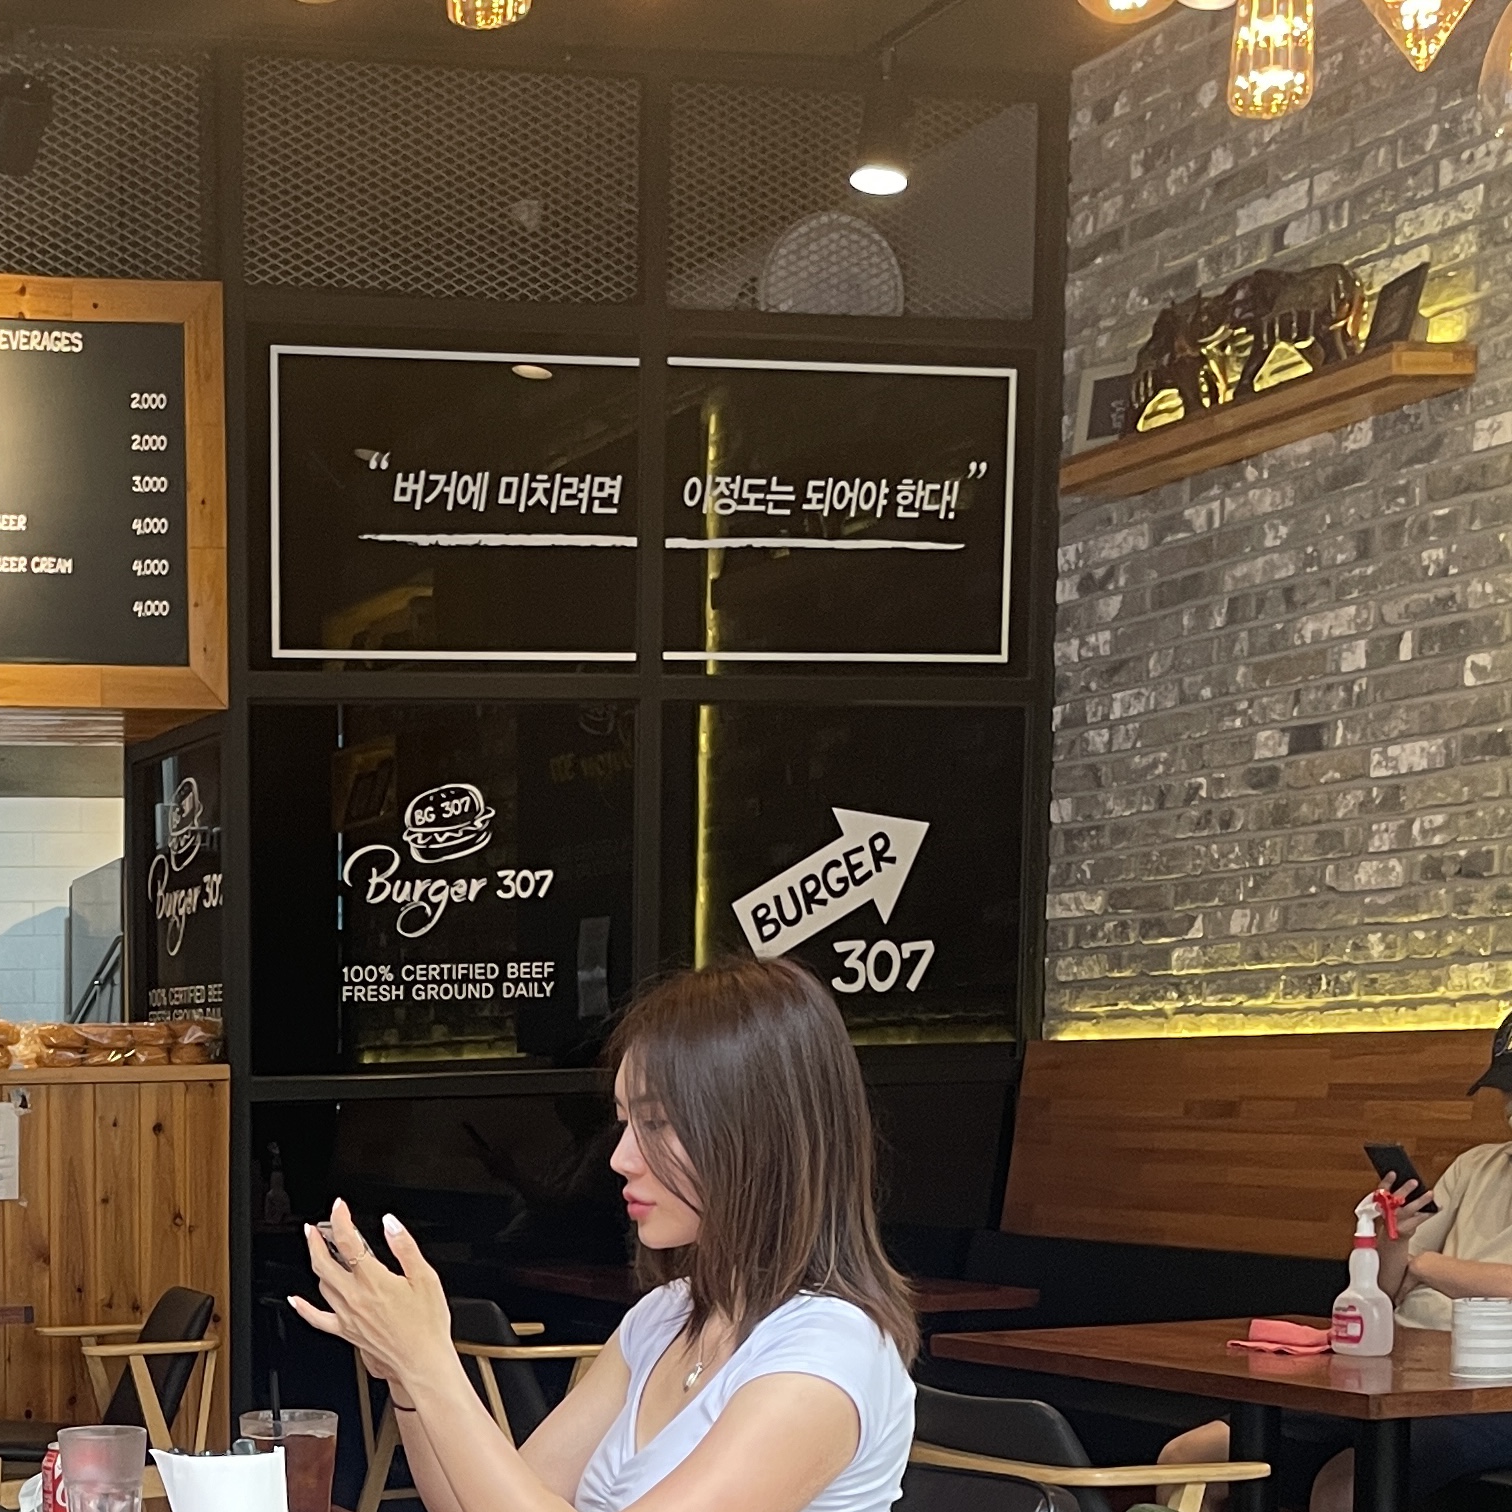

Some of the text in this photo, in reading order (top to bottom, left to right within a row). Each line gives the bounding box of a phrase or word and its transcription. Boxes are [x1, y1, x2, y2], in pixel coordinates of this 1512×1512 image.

[498, 472, 622, 514] 미치려면
[683, 475, 796, 516] 이정도는
[802, 477, 890, 518] 되어야
[30, 556, 74, 575] CREAM
[414, 796, 472, 826] BG 307
[148, 854, 223, 956] Burger 30
[343, 844, 555, 938] Burger 307
[750, 831, 897, 944] BURGER
[341, 961, 556, 983] 100% CERTIFIED BEEF
[831, 938, 936, 994] 307
[341, 981, 556, 1002] FRESH GROUND DAILY
